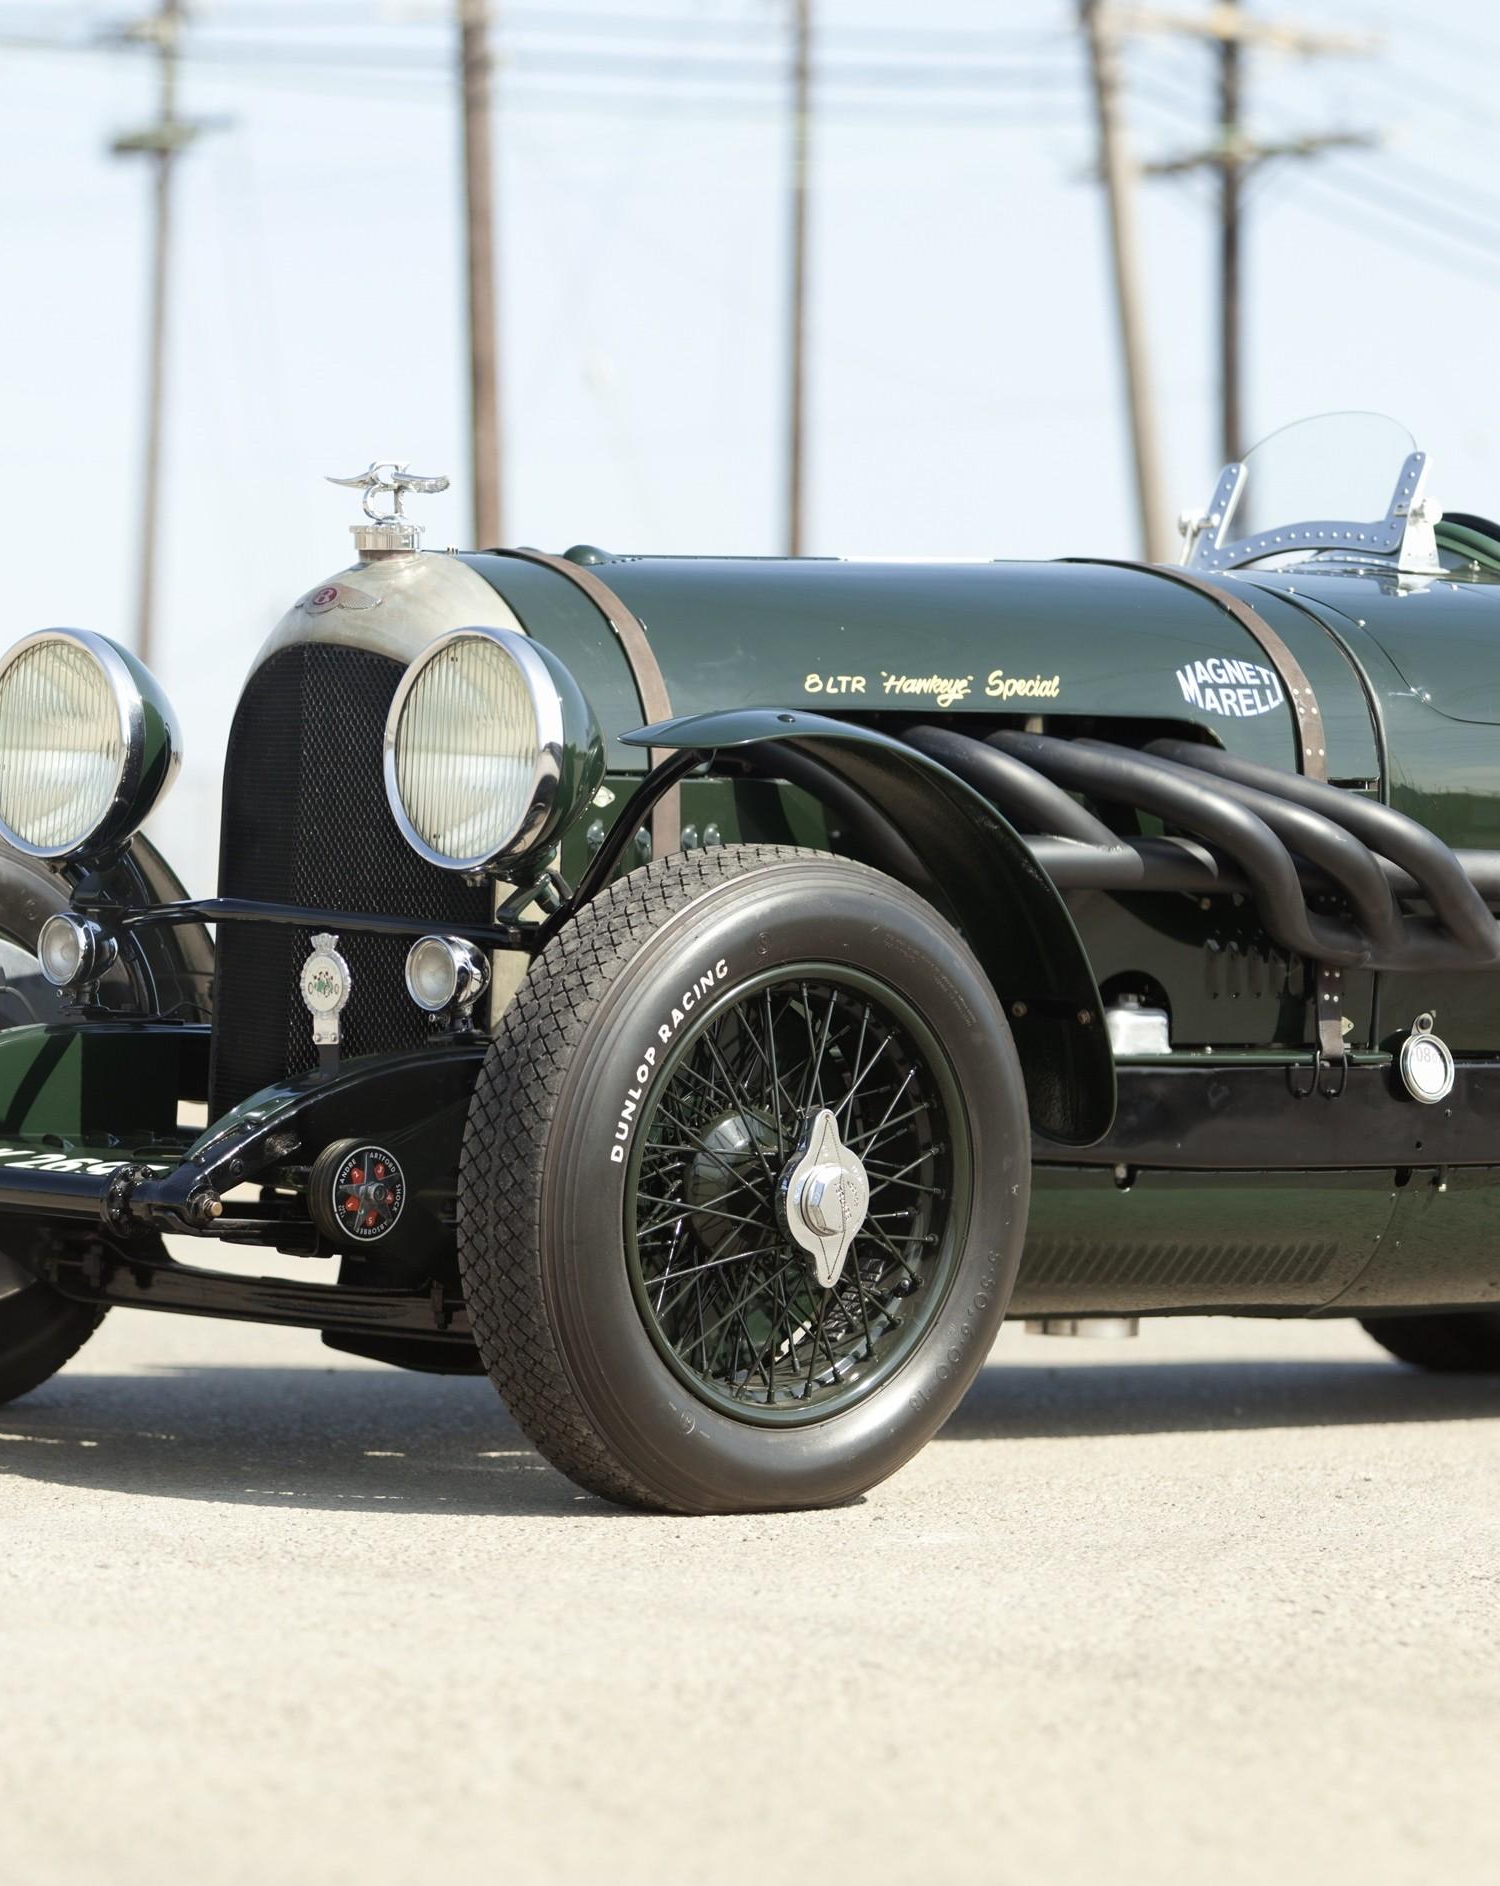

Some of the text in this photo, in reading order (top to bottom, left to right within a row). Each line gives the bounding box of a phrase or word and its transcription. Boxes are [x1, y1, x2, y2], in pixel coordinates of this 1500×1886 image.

[985, 670, 1060, 700] Special
[1176, 658, 1282, 698] MAGNETI
[610, 959, 729, 1163] DUNLOP RACING
[4, 1153, 170, 1177] 269
[339, 1152, 402, 1235] ANDRE ARTFORD SHOCK ABSORBE
